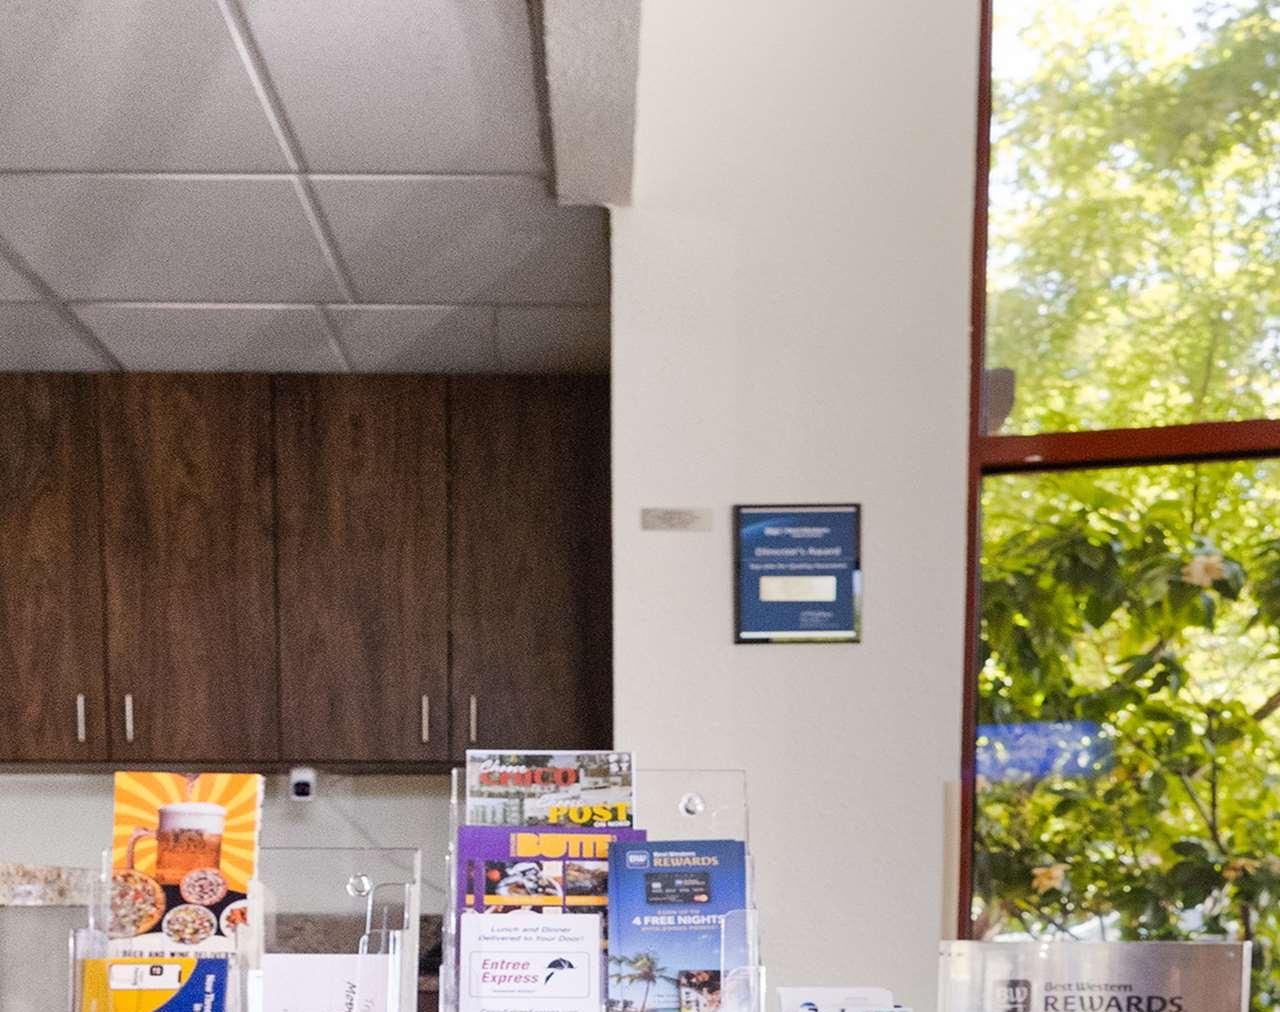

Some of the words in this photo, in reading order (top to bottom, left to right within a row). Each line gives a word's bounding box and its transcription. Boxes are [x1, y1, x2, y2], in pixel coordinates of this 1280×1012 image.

[548, 801, 631, 825] POST
[652, 856, 720, 868] REWARDS
[632, 916, 642, 926] 4
[644, 916, 675, 926] FREE
[677, 915, 725, 926] NIGHTS
[490, 924, 520, 933] Lunch
[541, 924, 572, 933] Dinner
[481, 959, 531, 971] Entree
[480, 971, 540, 985] Express
[1044, 981, 1072, 992] Best
[1075, 982, 1133, 992] Western
